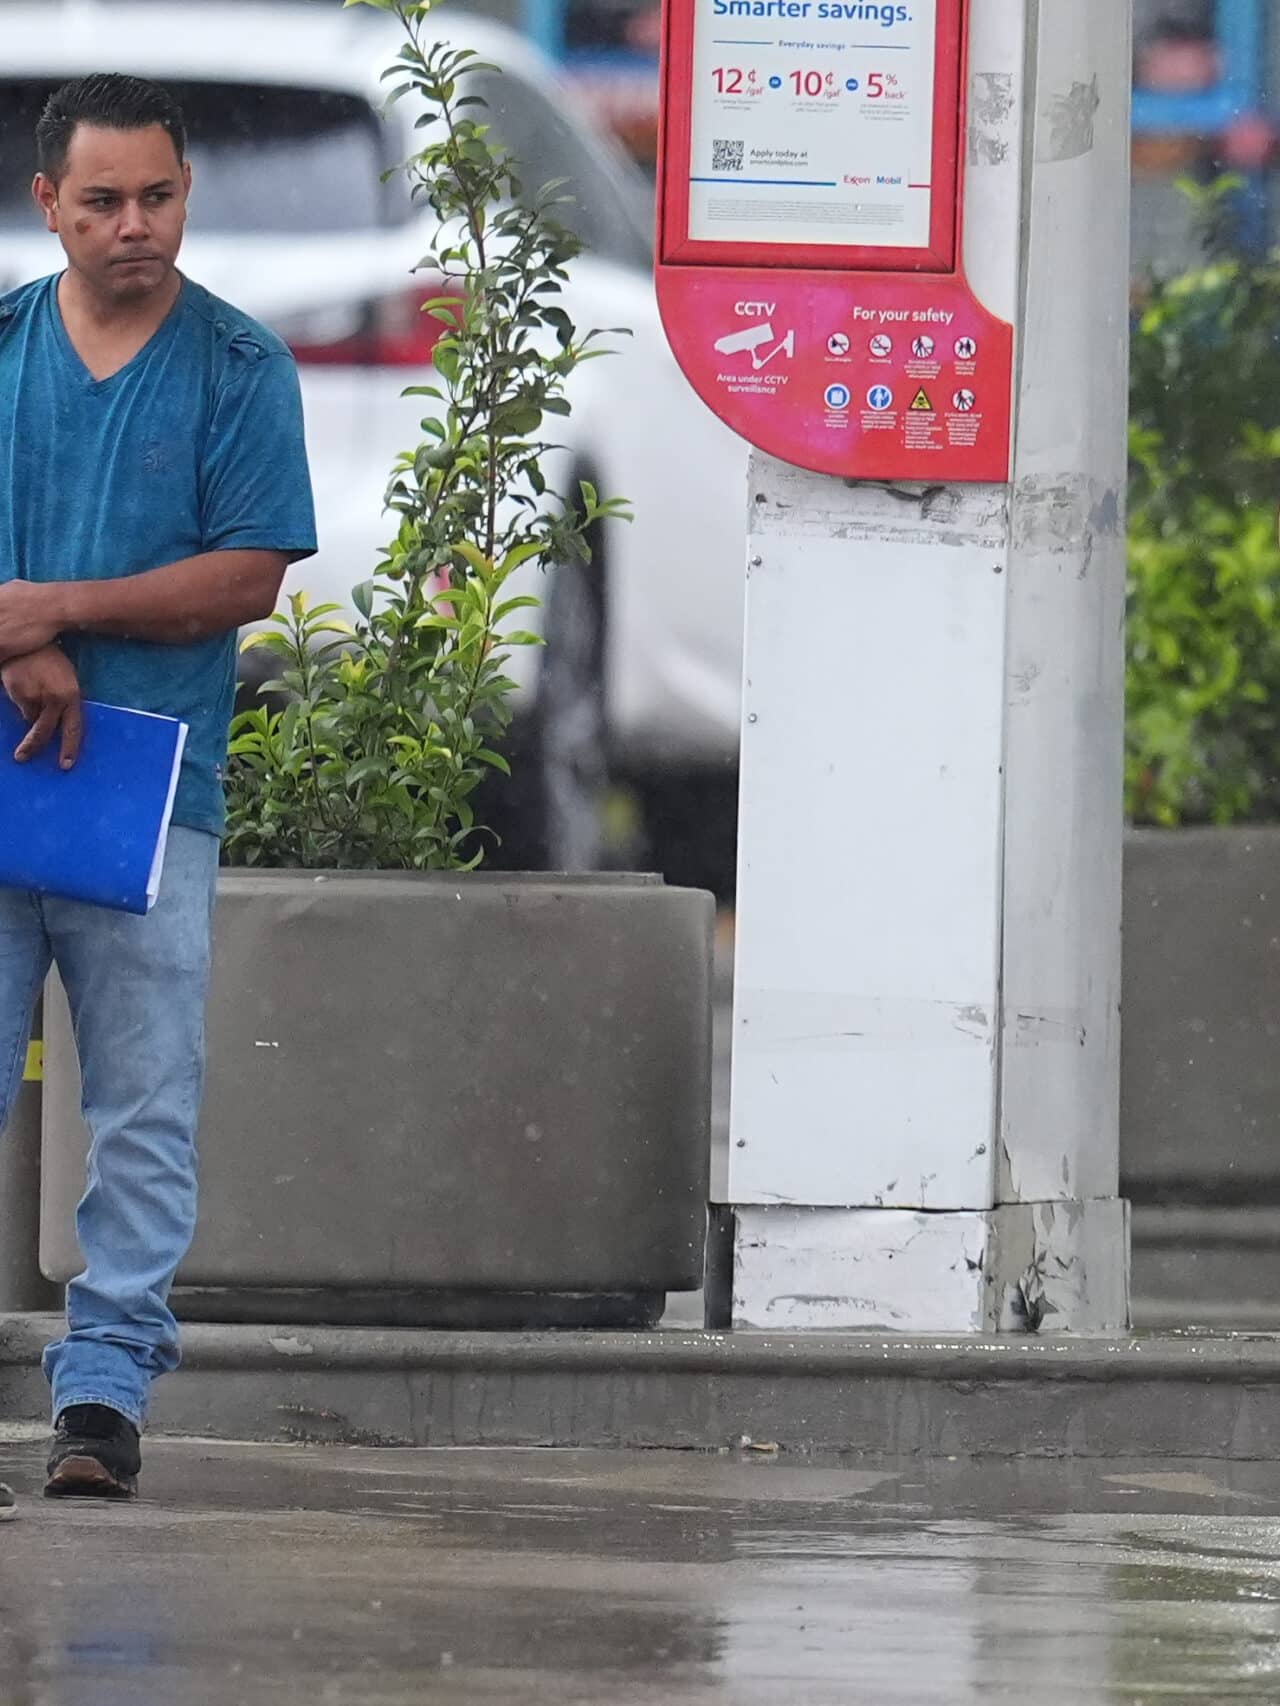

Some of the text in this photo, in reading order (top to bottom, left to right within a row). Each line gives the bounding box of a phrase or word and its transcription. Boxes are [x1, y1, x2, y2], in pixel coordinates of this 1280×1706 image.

[713, 0, 913, 27] Smarter savings.
[778, 39, 846, 51] Everyday savings
[750, 149, 773, 158] Apply
[775, 150, 798, 159] today
[843, 175, 902, 186] Exxon Mobil
[734, 301, 776, 317] CCTV
[853, 306, 953, 326] For your safety
[716, 373, 788, 386] Area under CCTV
[727, 384, 776, 395] surveillance
